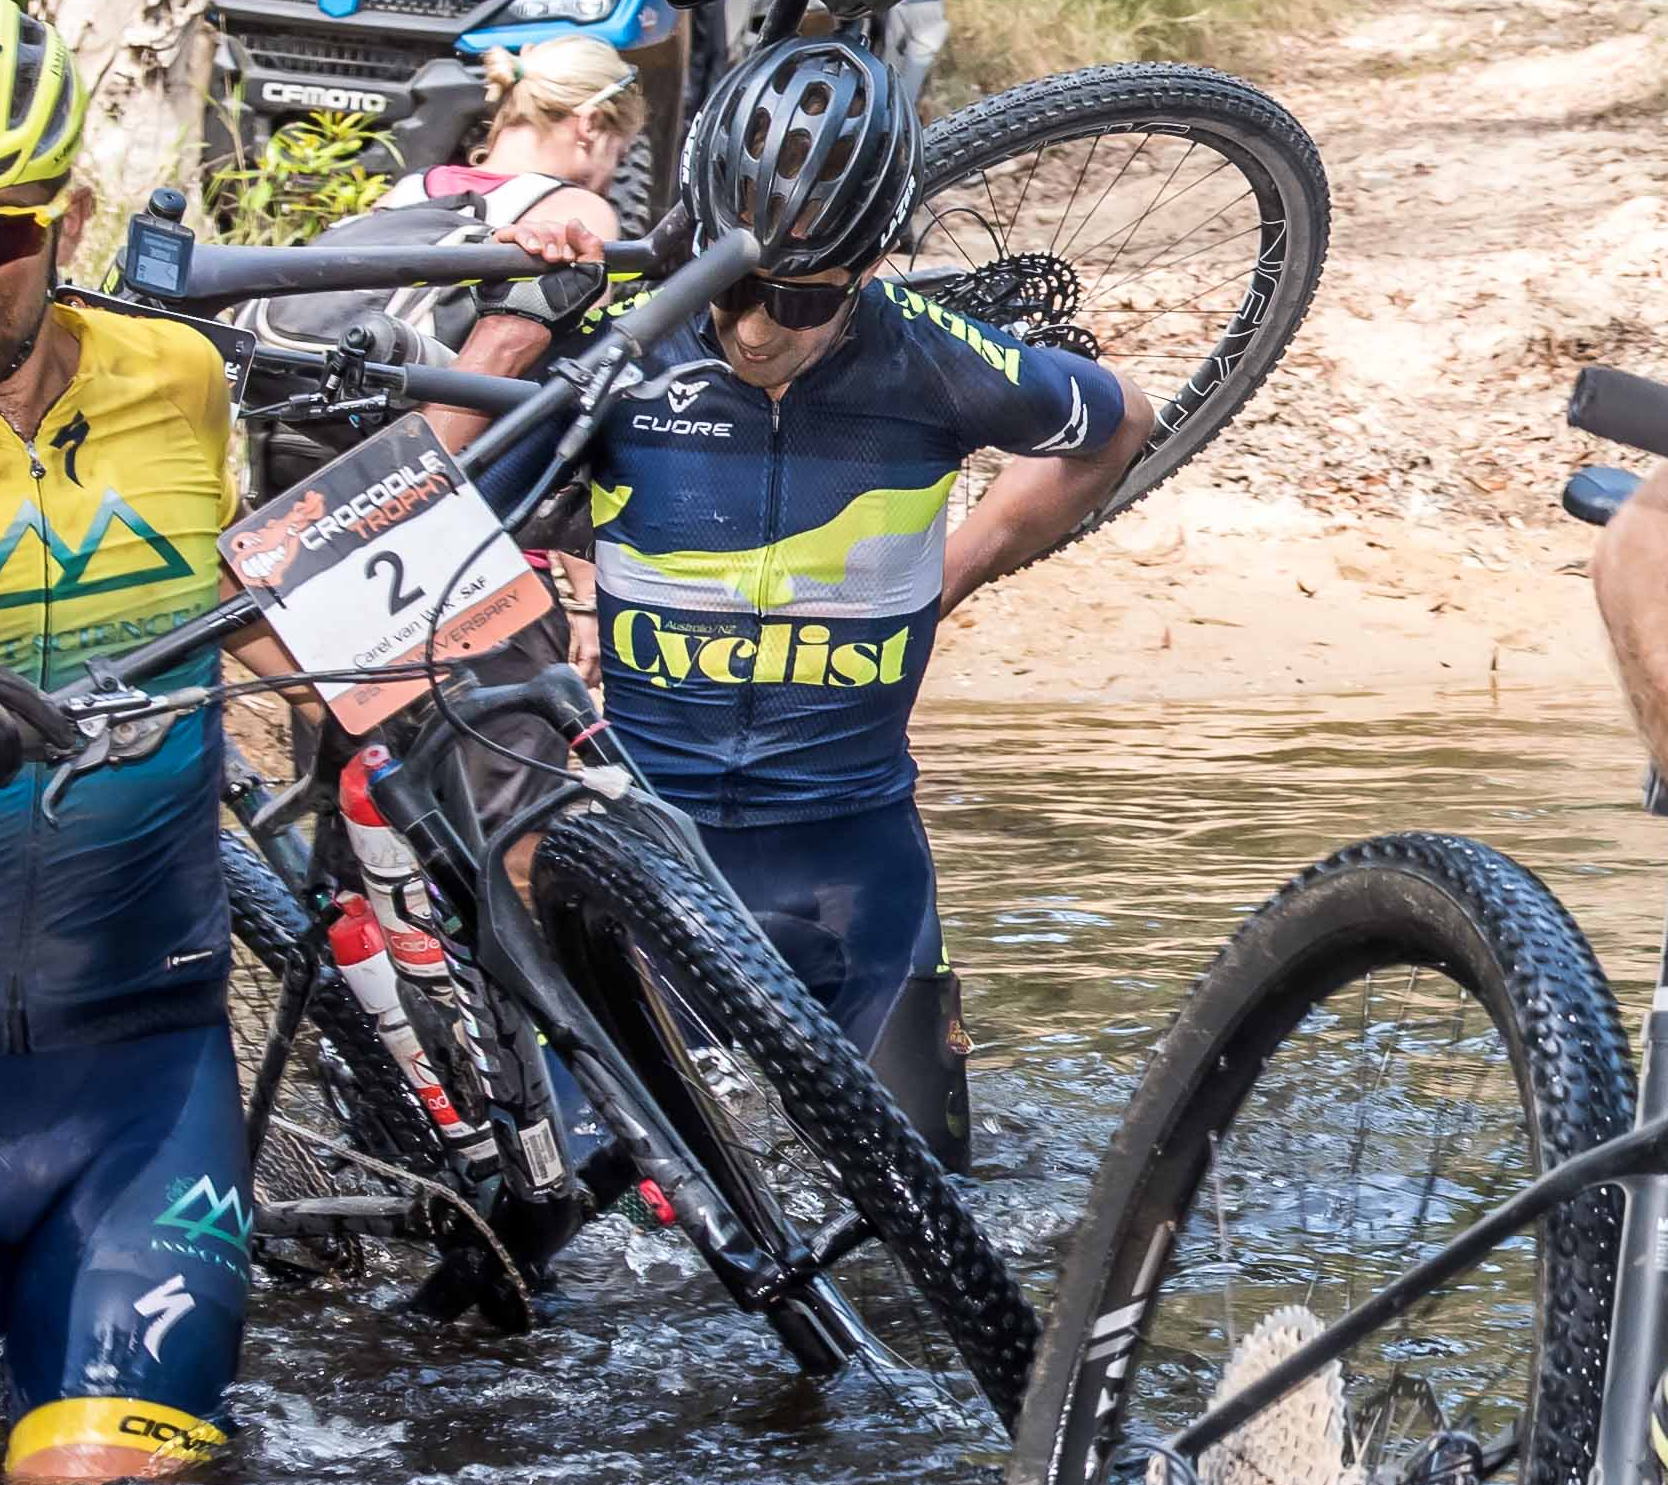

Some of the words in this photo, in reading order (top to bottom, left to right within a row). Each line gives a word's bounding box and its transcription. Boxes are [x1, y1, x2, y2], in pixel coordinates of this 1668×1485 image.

[261, 82, 388, 113] CFMOTO
[880, 173, 918, 249] LAZER
[632, 414, 733, 437] CUORE
[299, 449, 448, 551] CROCODILE
[364, 550, 426, 616] 2
[394, 617, 423, 643] van
[459, 574, 489, 600] SAF
[612, 609, 912, 689] Cyclist
